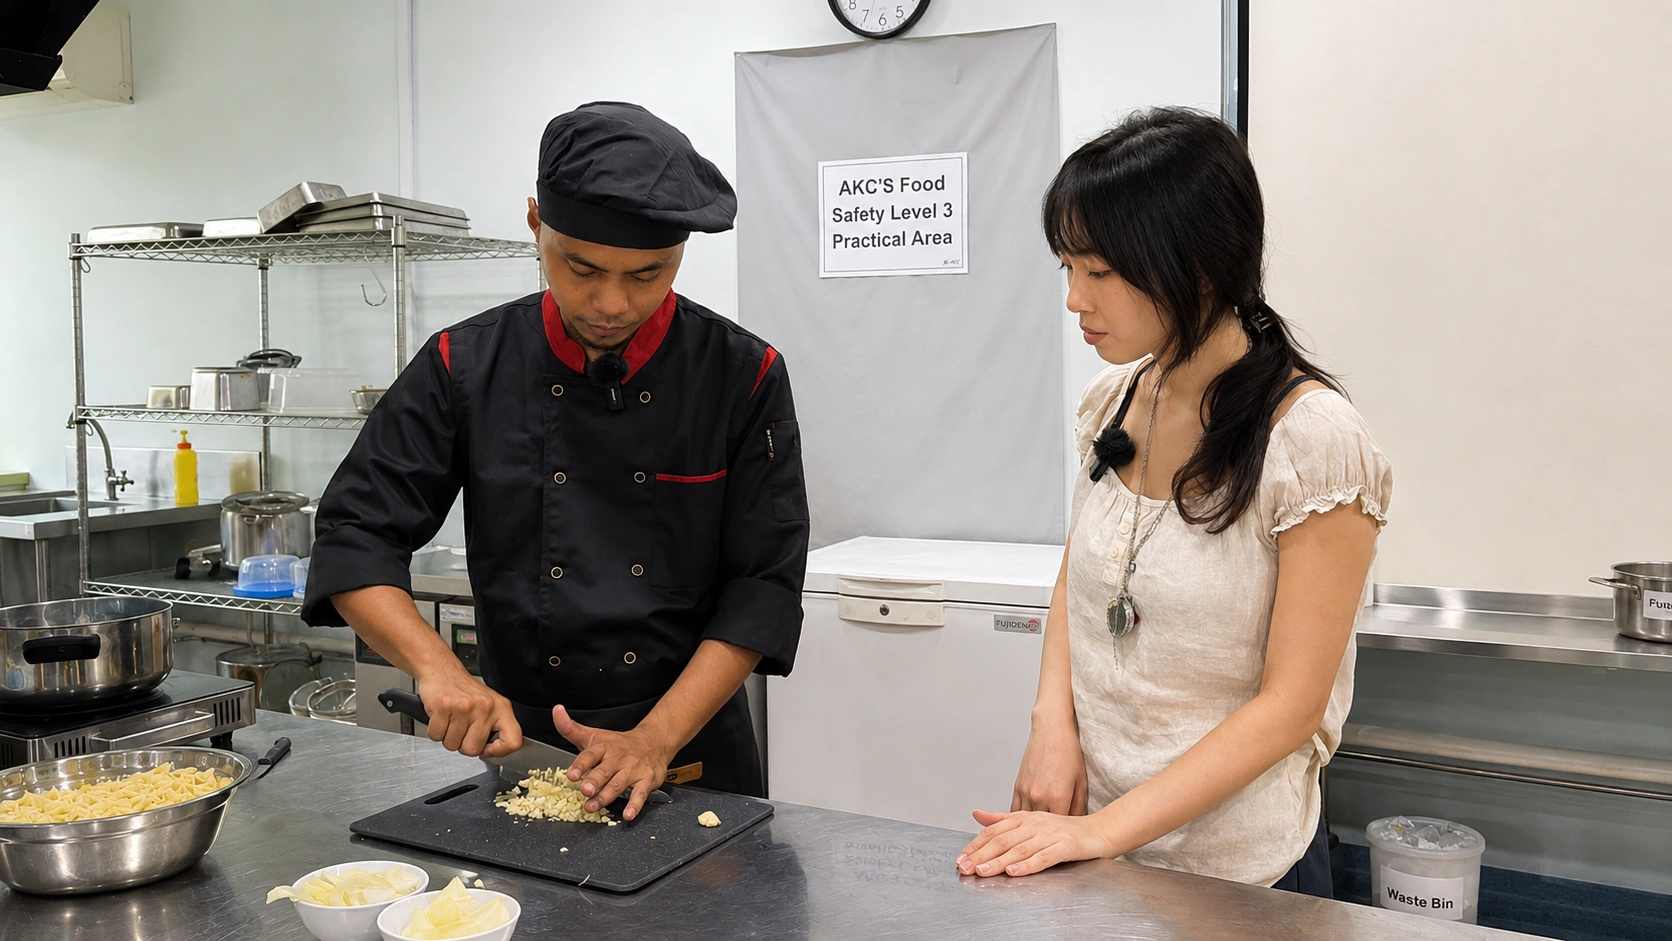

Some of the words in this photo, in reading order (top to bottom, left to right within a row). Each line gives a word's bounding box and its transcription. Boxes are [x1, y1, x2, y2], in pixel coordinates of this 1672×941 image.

[848, 0, 857, 10] 8
[895, 5, 904, 19] 5
[862, 9, 870, 23] 7
[878, 12, 887, 26] 6
[838, 178, 894, 196] AKC’S
[900, 175, 945, 193] Food
[832, 206, 885, 225] Safety
[891, 203, 937, 220] Level
[943, 202, 953, 218] 3
[833, 231, 906, 249] Practical
[911, 230, 953, 246] Area
[1387, 887, 1427, 907] Waste
[1431, 898, 1454, 909] Bin
